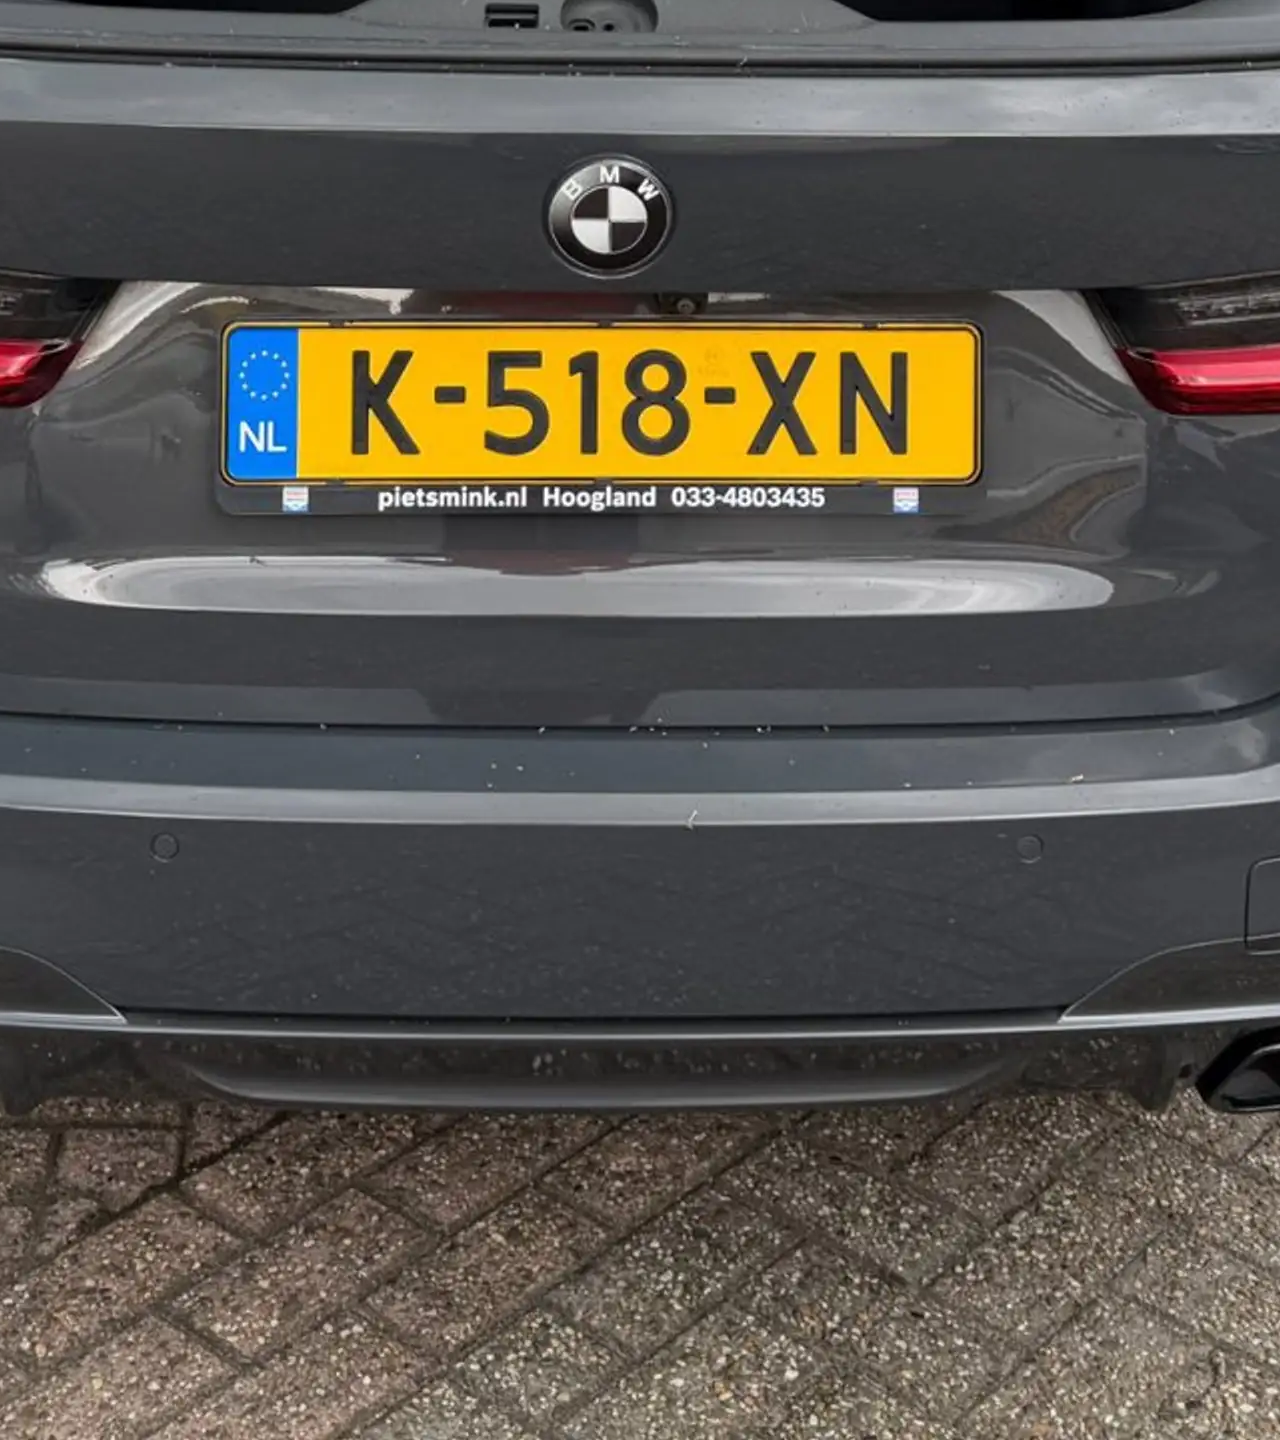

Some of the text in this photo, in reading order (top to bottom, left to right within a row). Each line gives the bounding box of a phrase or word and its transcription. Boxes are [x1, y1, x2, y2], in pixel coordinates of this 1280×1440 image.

[561, 164, 661, 203] BMW
[350, 348, 910, 458] K-518-XN
[238, 420, 288, 453] NL
[377, 485, 826, 512] pietsmink.nl Hoogland 033-4803435
